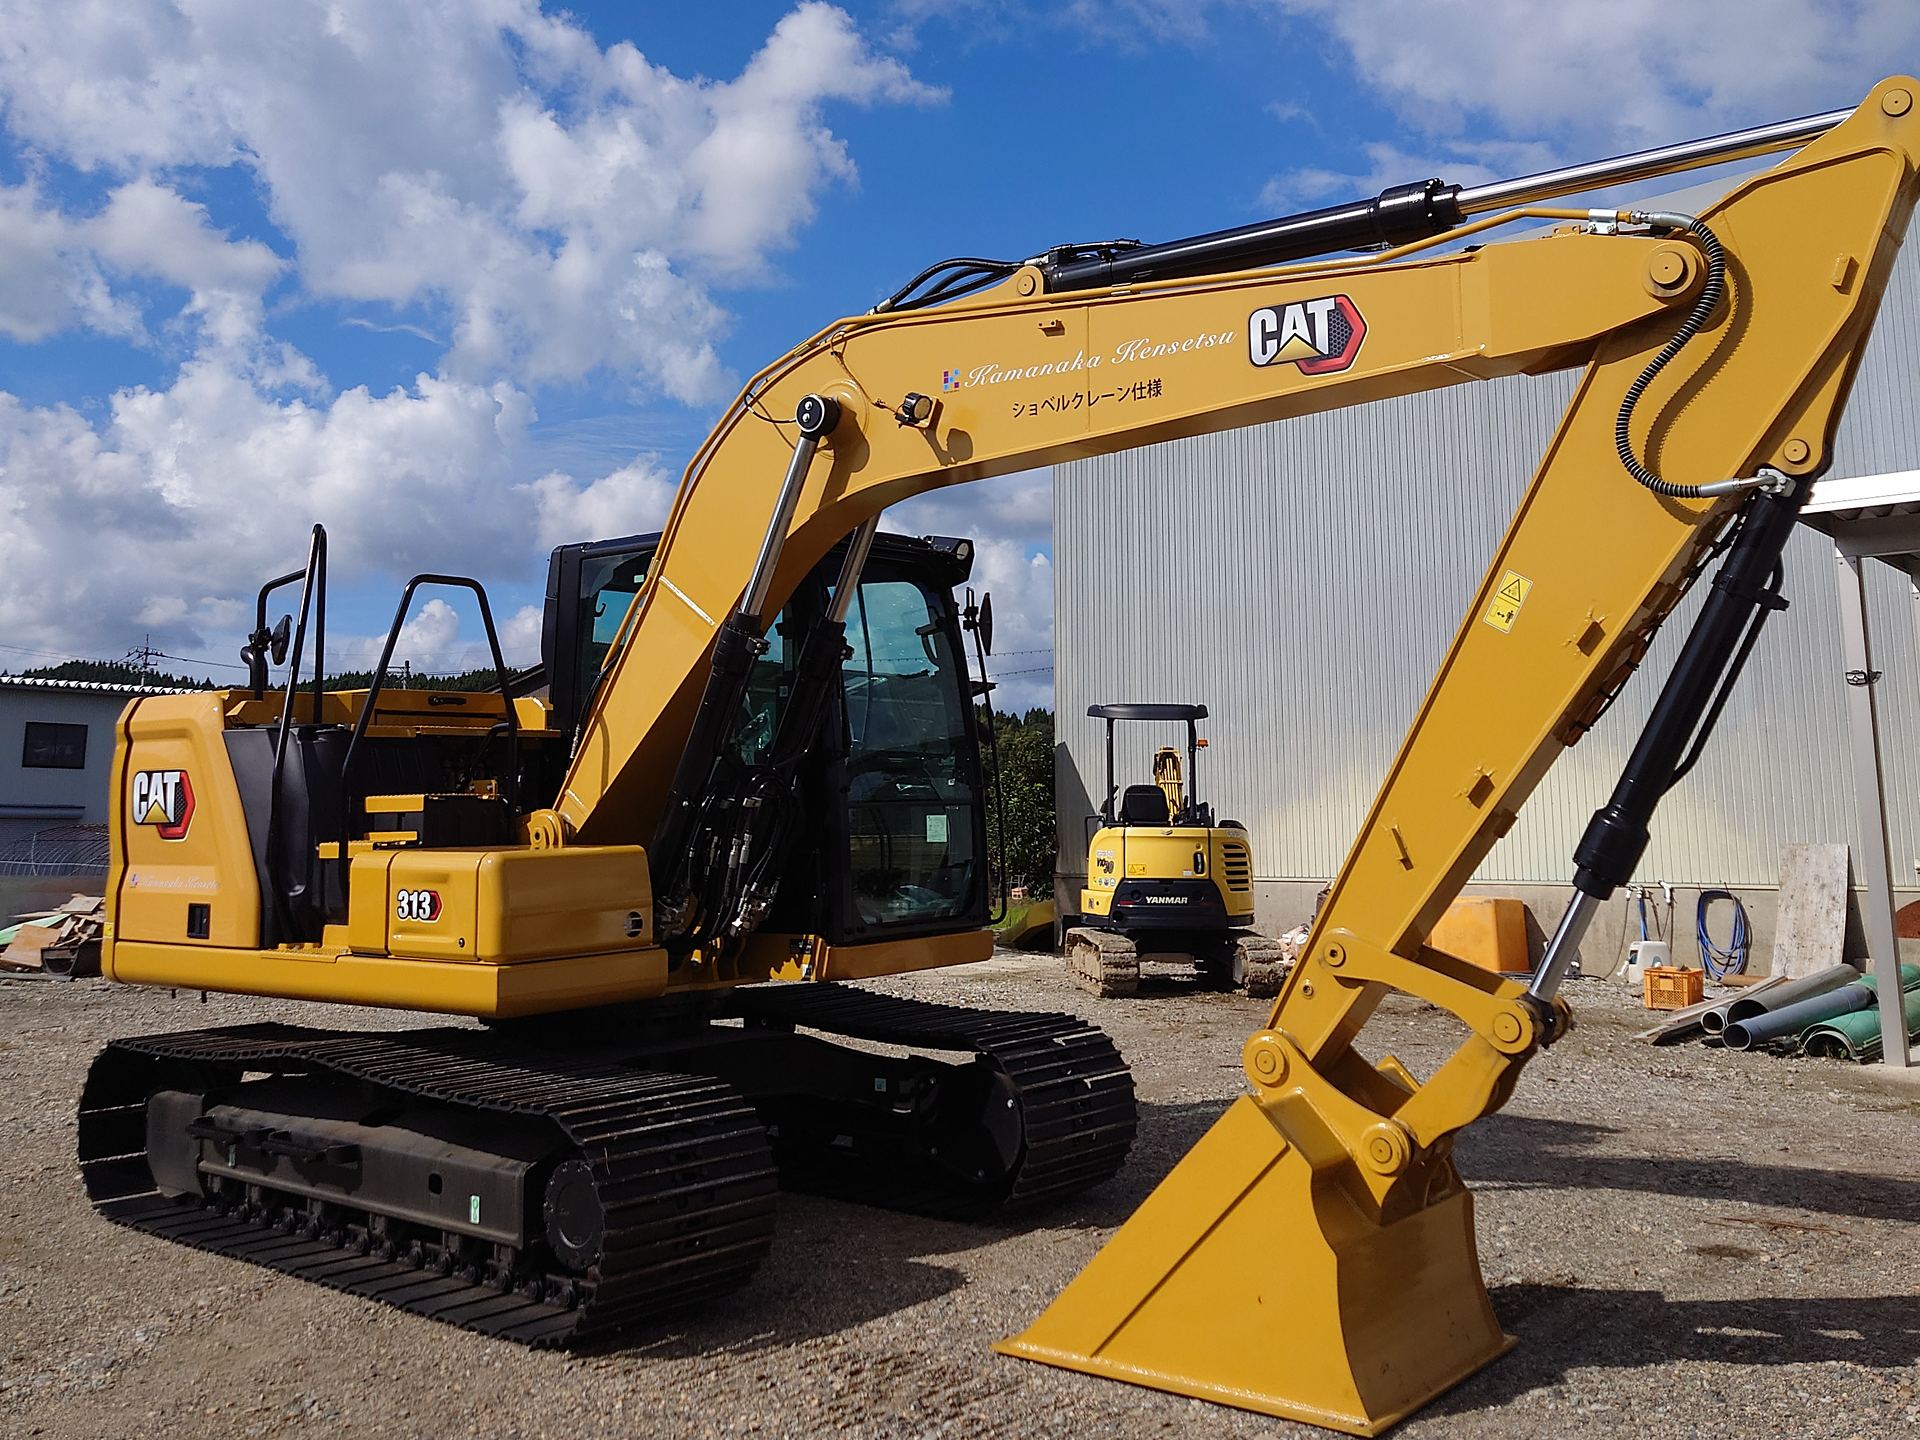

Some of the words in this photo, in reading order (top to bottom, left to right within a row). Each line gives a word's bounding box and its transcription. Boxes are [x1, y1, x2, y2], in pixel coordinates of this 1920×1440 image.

[1250, 297, 1336, 366] CAT
[964, 350, 1103, 388] Kamanaka
[1111, 329, 1237, 365] Kensetsu
[1012, 378, 1163, 419] ショベルクレーン仕様
[133, 771, 181, 824] CAT
[397, 889, 431, 919] 313
[1145, 895, 1188, 905] YANMAR
